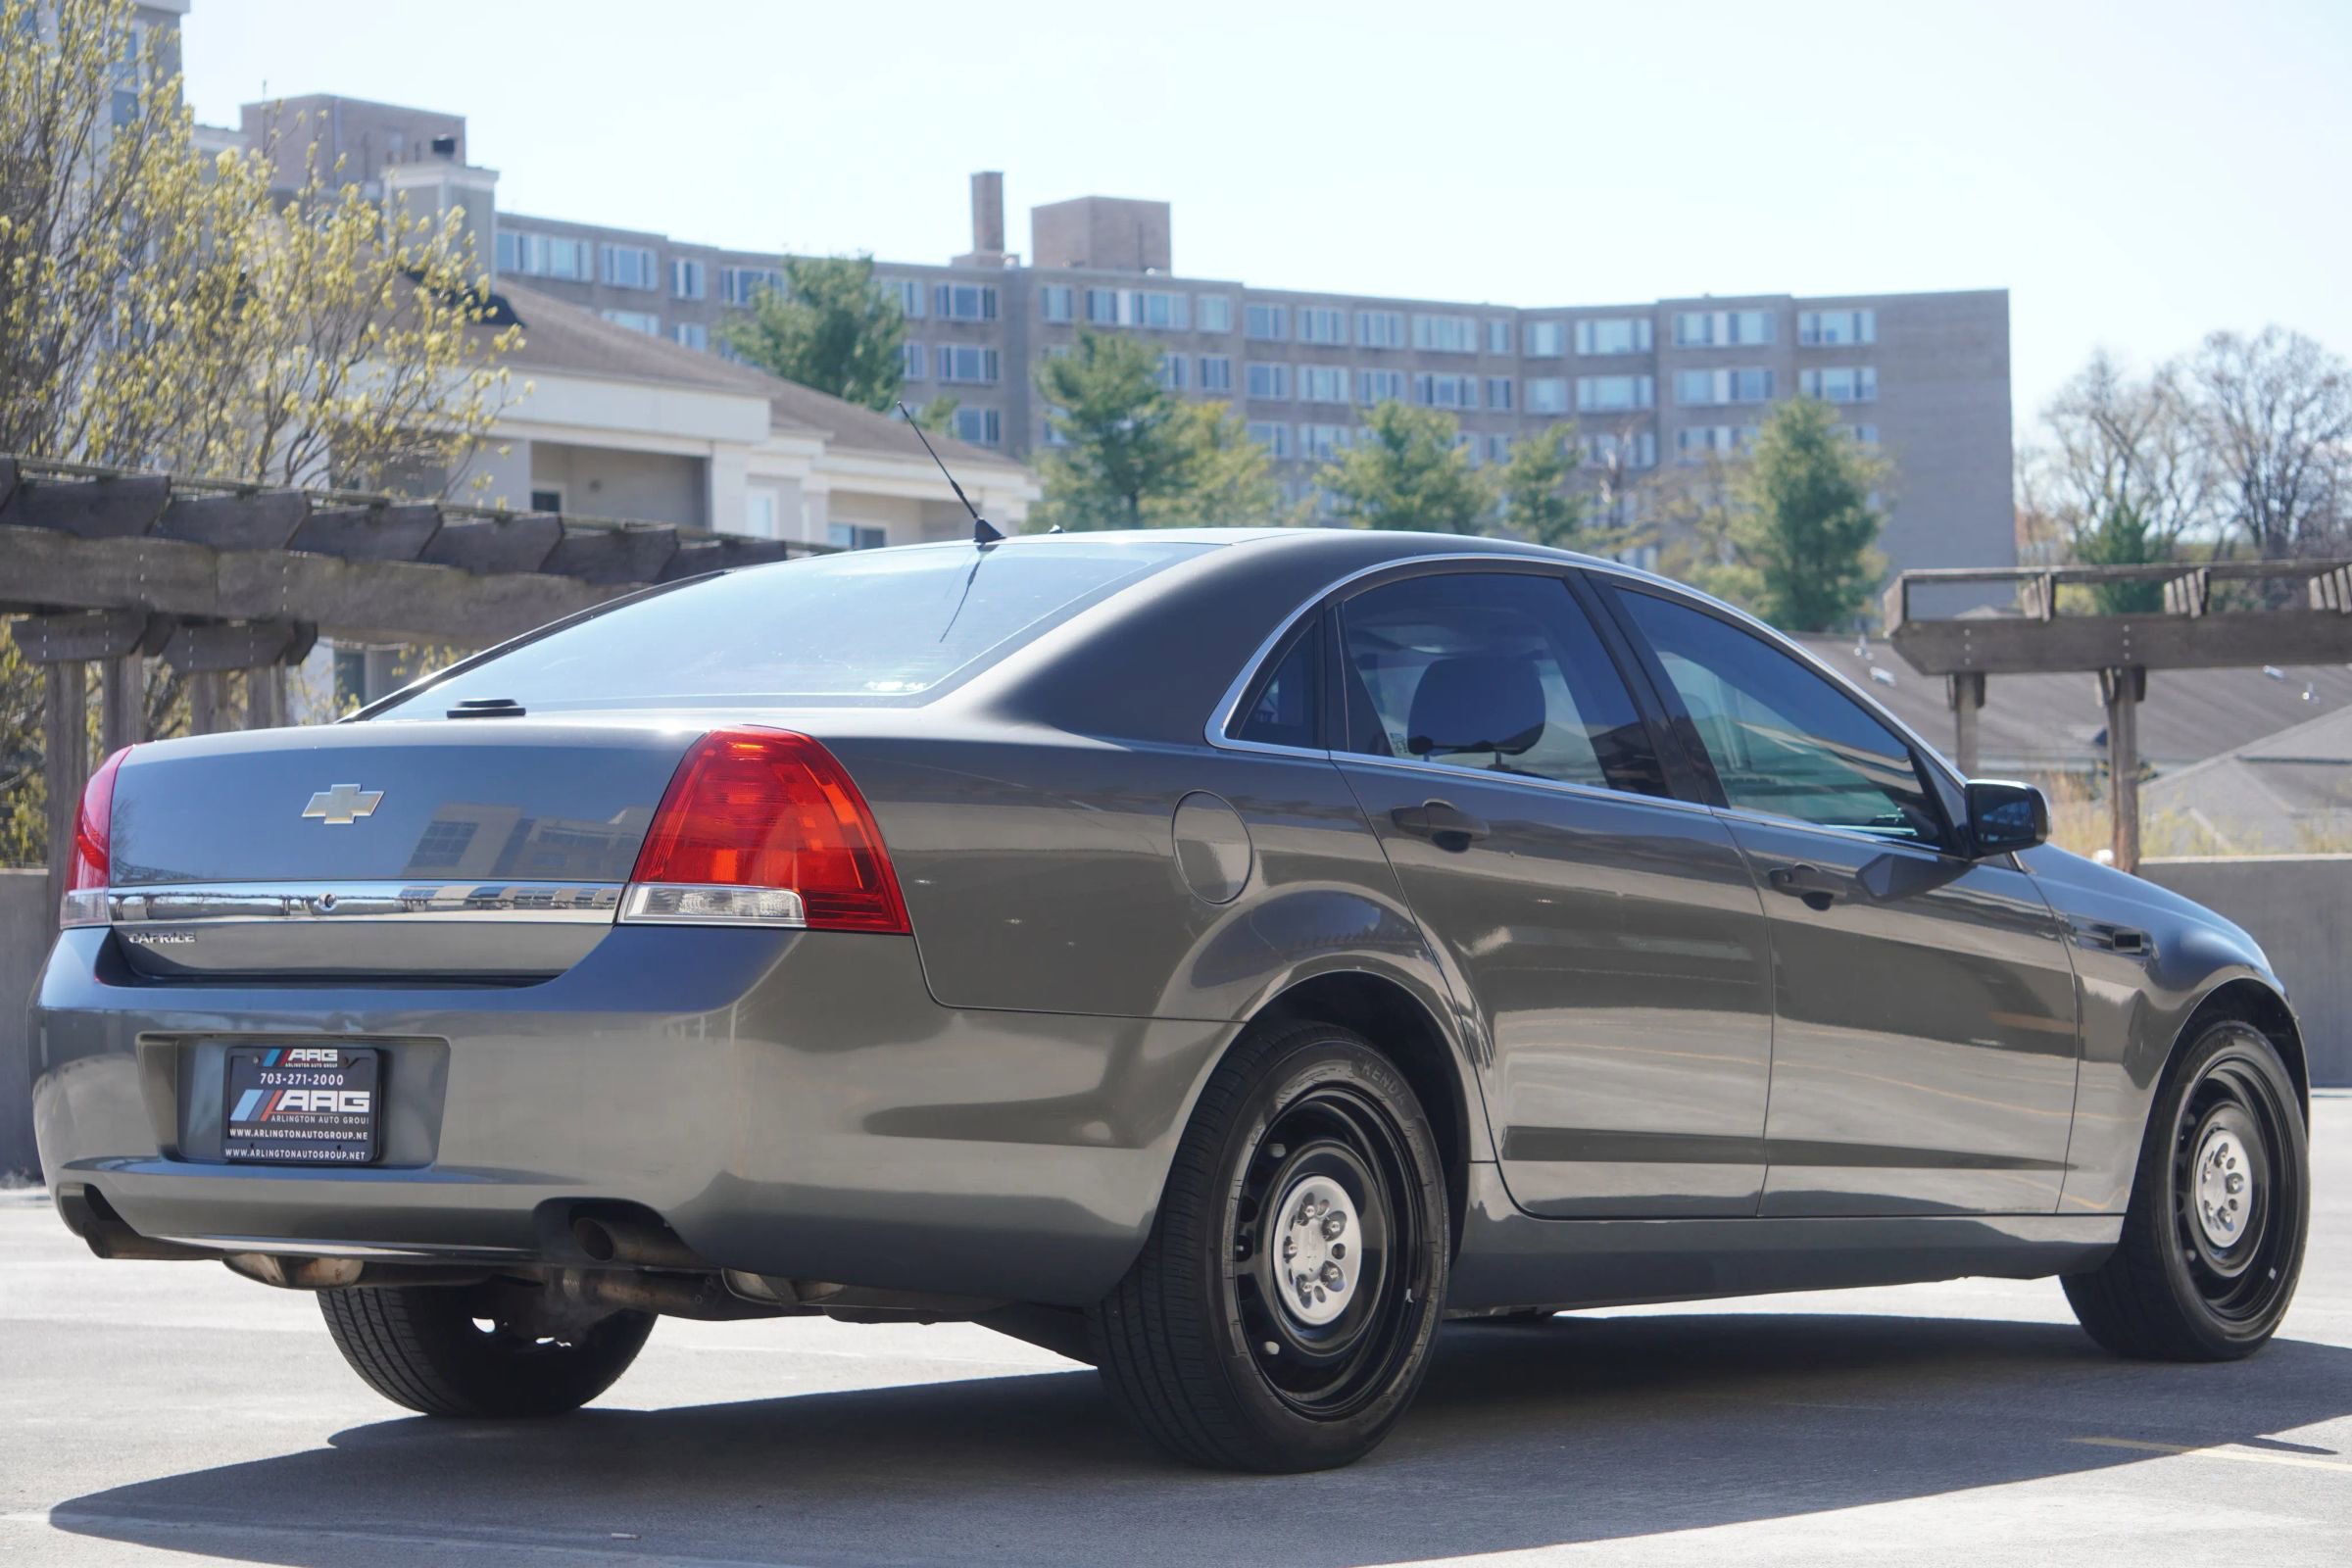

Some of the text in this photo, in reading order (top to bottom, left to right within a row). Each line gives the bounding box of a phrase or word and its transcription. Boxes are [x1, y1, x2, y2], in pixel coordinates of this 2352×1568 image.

[287, 1049, 338, 1061] AAG
[260, 1073, 344, 1086] 703-271-2000
[275, 1090, 370, 1112] AAG
[270, 1114, 316, 1124] ARLINGTON
[318, 1115, 340, 1124] AUTO
[229, 1128, 368, 1141] WWW.ARLINGTONAUTOGROUP.NE
[225, 1148, 366, 1160] WWW.ARLINGTONAUTOGROUP.NET
